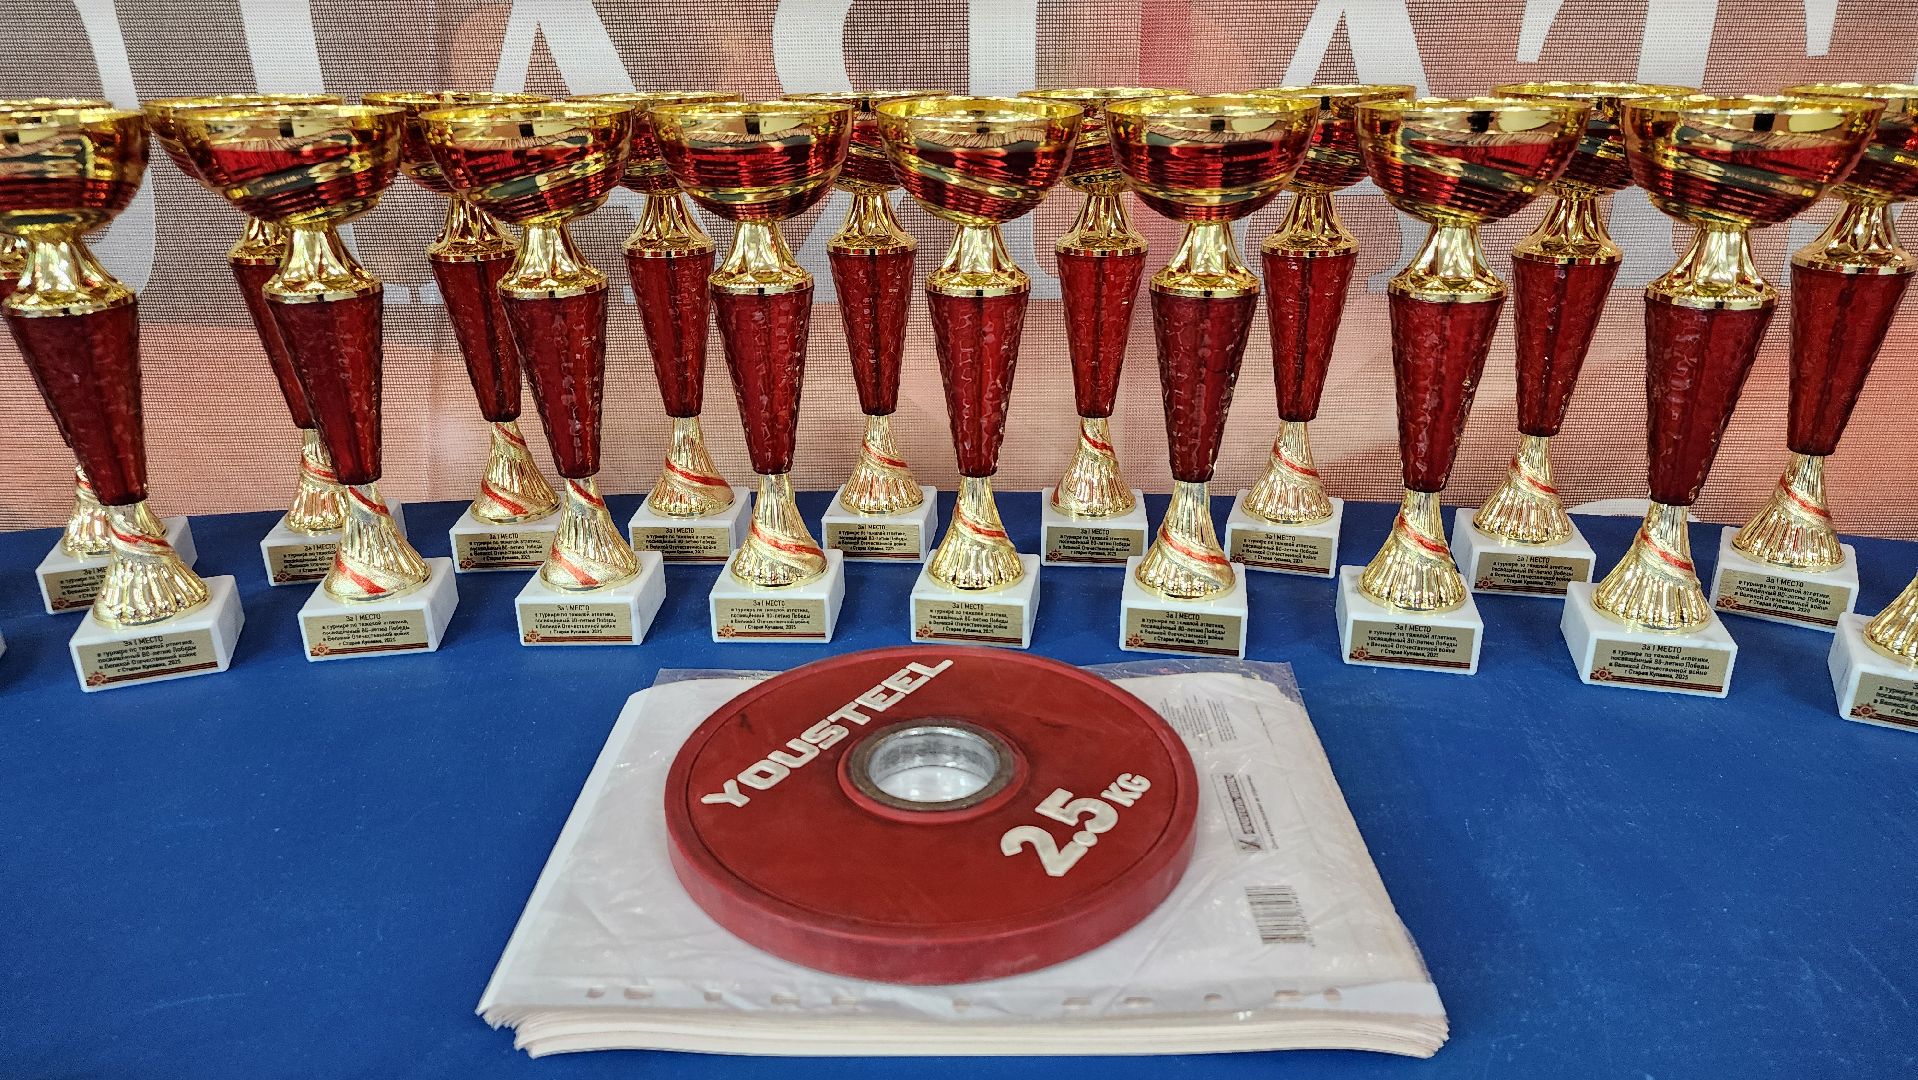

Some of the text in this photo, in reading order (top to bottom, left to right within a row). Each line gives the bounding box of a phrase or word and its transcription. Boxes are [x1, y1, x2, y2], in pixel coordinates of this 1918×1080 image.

[1408, 624, 1431, 632] МЕСТО
[1656, 644, 1682, 653] МЕСТО
[1685, 661, 1709, 669] Победы
[701, 659, 954, 808] YOUSTEEL
[1001, 788, 1118, 877] 2.5
[1101, 773, 1151, 807] KG
